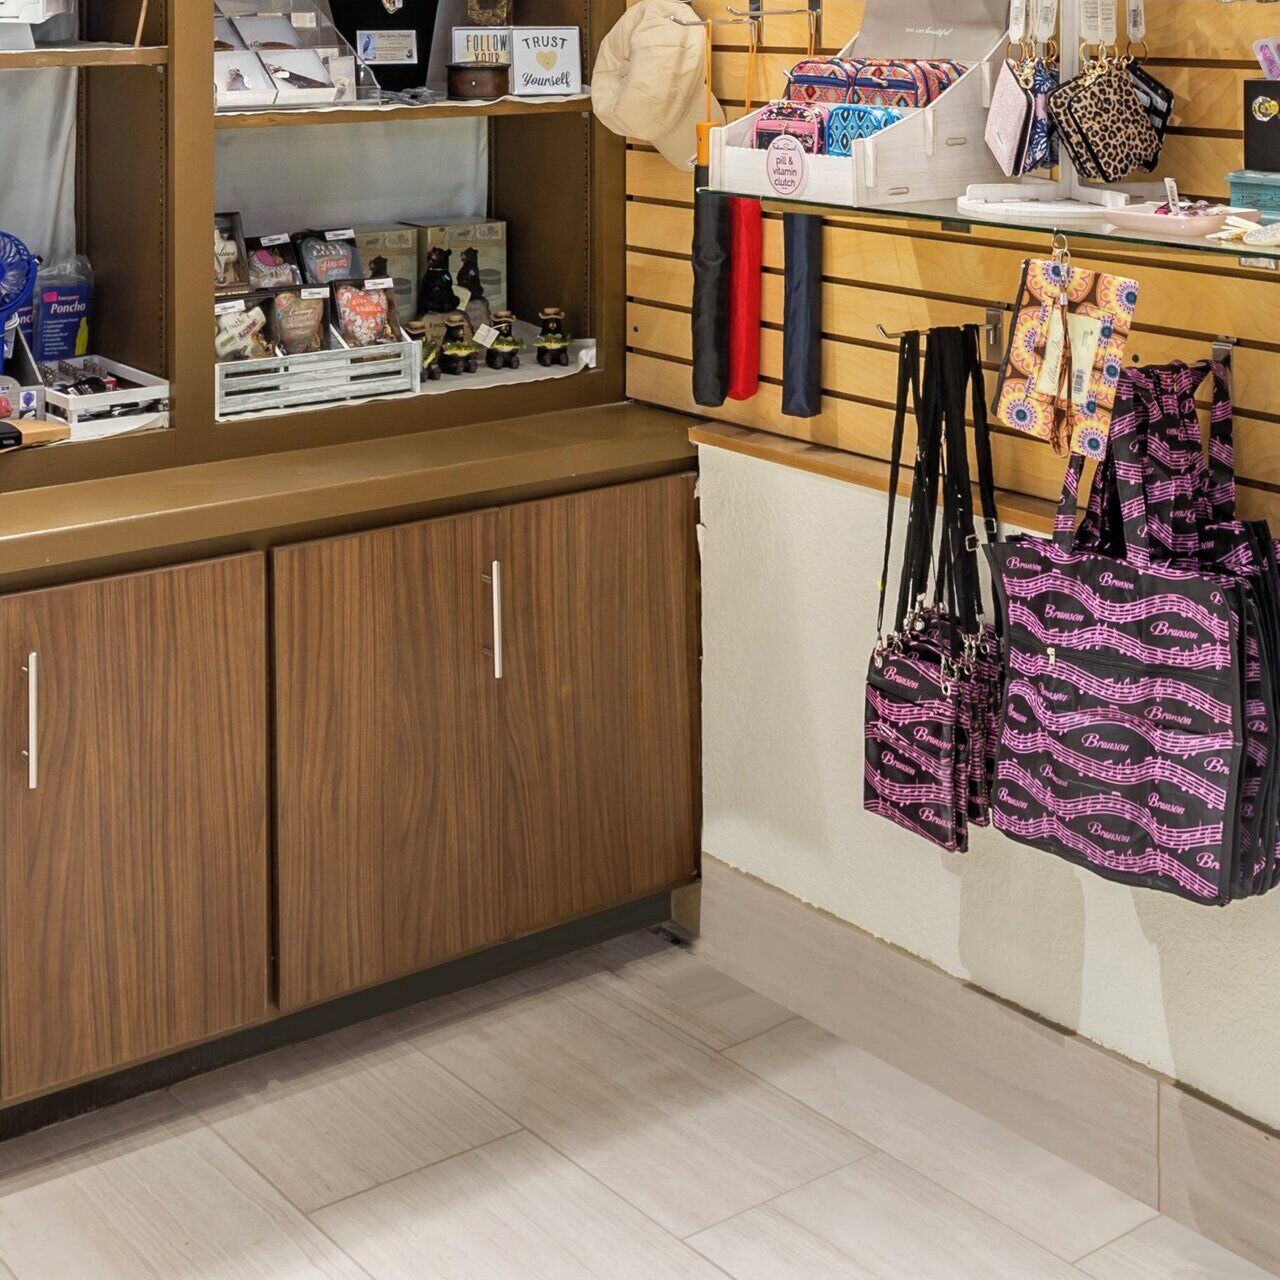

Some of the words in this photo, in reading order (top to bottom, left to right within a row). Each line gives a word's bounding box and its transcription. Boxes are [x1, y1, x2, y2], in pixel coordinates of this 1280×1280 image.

[466, 34, 508, 51] FOLLOW
[522, 36, 568, 49] TRUST
[521, 71, 572, 88] Yourself
[776, 155, 787, 168] pill
[788, 156, 794, 165] &
[772, 167, 797, 177] vitamin
[774, 177, 796, 188] clutch
[50, 301, 86, 314] Poncho
